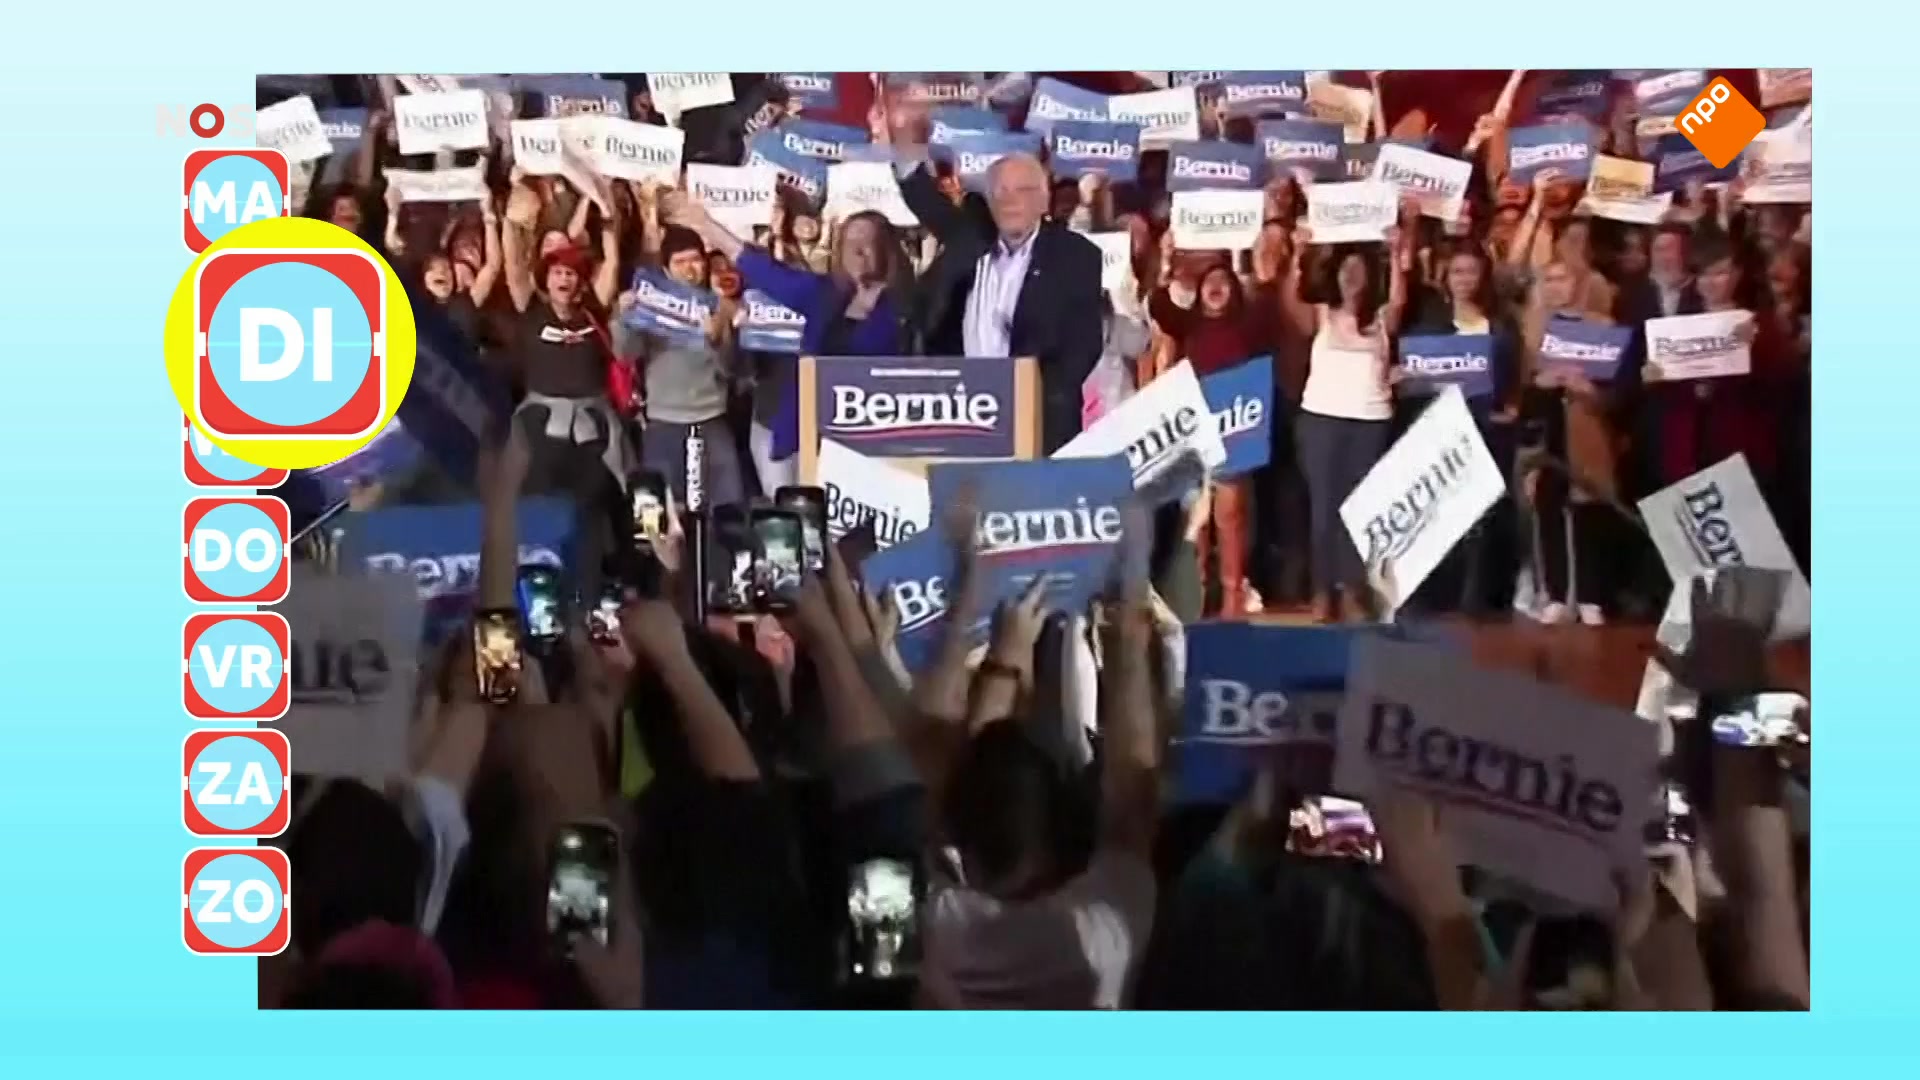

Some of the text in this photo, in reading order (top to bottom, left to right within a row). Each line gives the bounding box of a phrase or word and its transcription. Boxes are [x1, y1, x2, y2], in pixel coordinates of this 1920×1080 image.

[1057, 135, 1134, 160] Bernie
[832, 383, 999, 426] Bernie
[1365, 696, 1624, 832] Bernie
